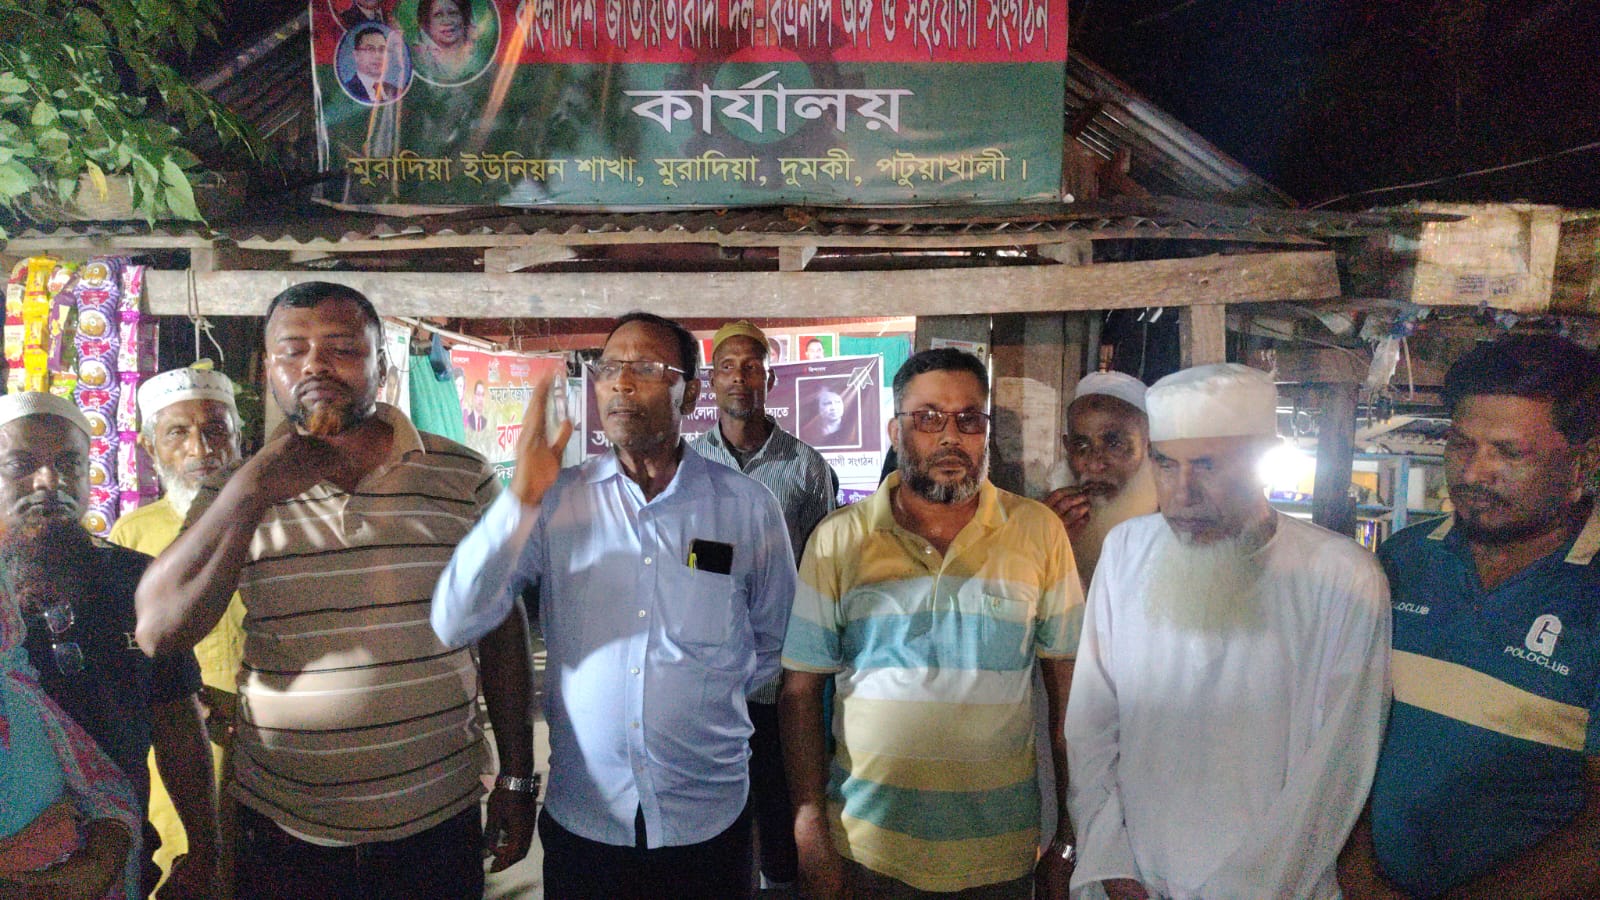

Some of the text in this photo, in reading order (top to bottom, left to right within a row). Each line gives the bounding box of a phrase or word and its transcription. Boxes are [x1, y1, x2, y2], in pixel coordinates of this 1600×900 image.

[623, 70, 915, 135] কার্যালয়
[347, 150, 452, 187] মুরাদিয়া
[460, 151, 567, 184] ইউনিয়ন
[575, 156, 645, 187] শাখা,
[654, 150, 767, 188] মুরাদিয়া,
[777, 149, 863, 187] দুমকী,
[877, 149, 1010, 187] পটুয়াখালী
[1504, 646, 1570, 676] POLOCLUB
